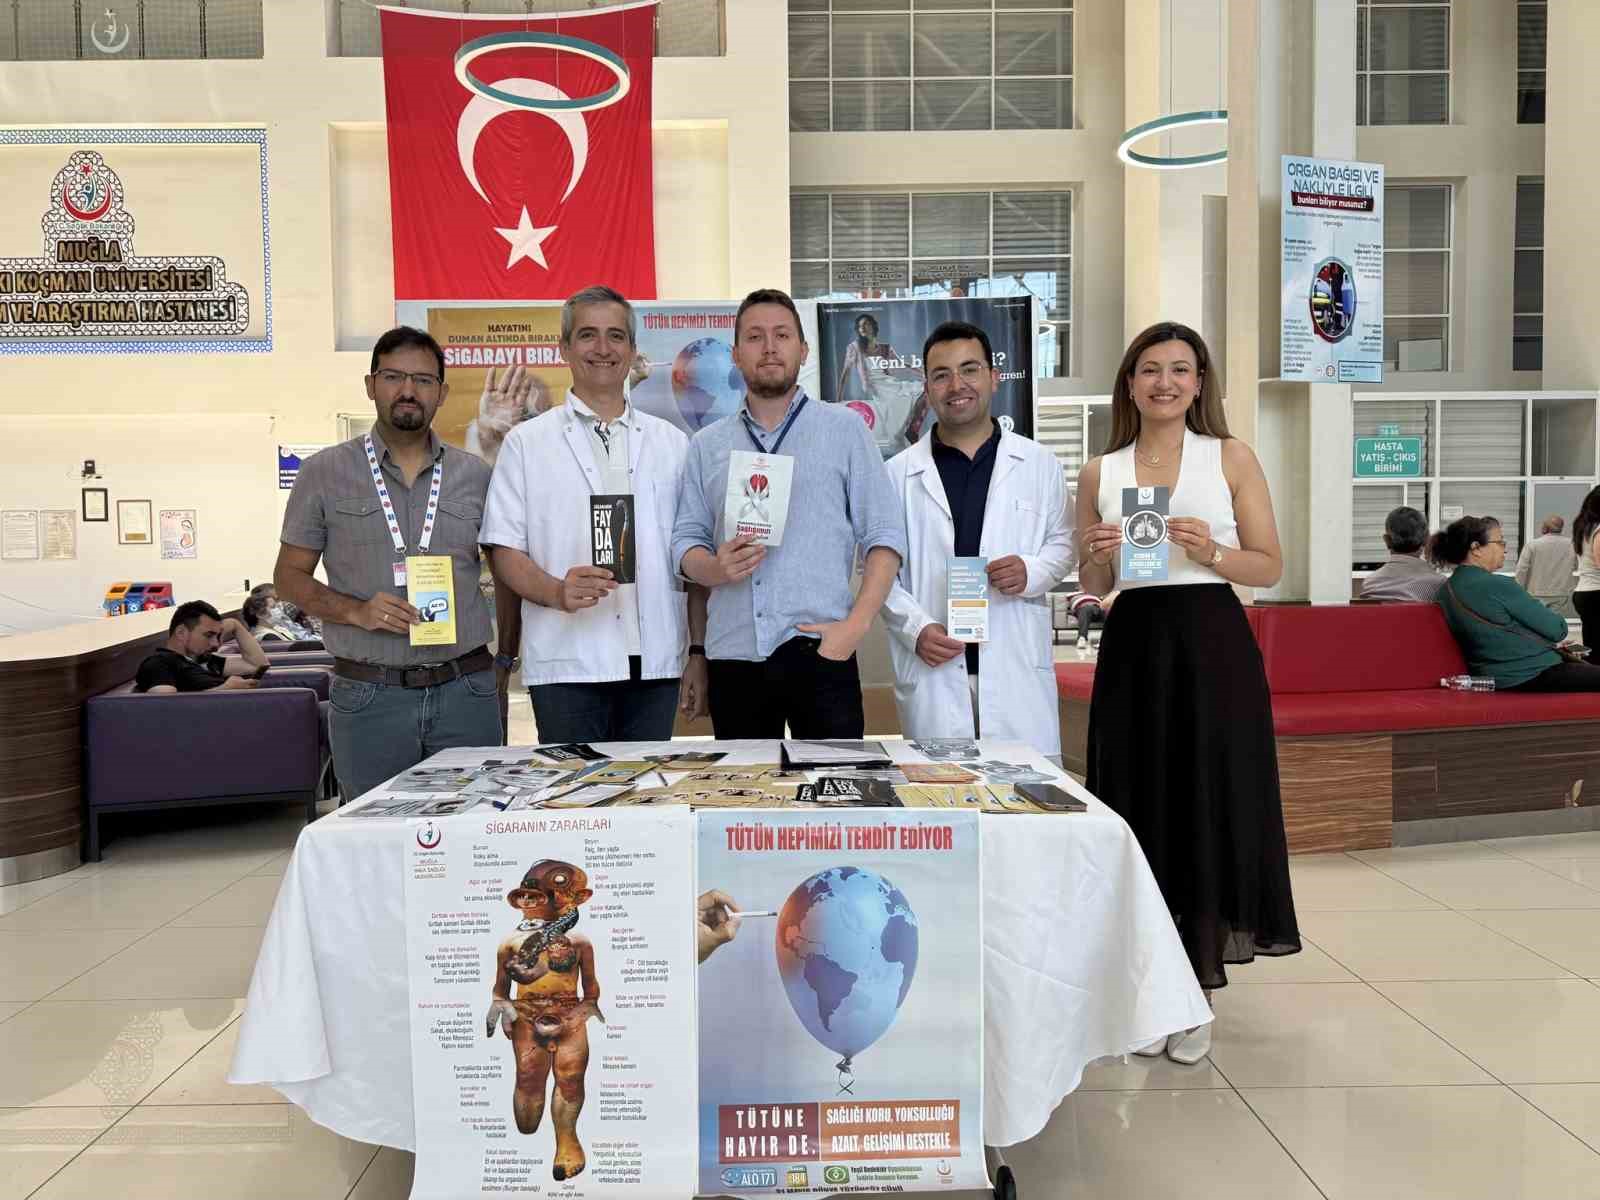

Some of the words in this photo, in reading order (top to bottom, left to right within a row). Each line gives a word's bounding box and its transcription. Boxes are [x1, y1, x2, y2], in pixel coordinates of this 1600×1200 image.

[1287, 162, 1327, 179] ORGAN
[1364, 170, 1379, 184] VE
[57, 237, 122, 262] MUĞLA
[15, 271, 92, 298] KOÇMAN
[94, 266, 213, 292] ÜNİVERSİTESİ
[10, 302, 33, 322] VE
[36, 301, 138, 327] ARAŞTIRMA
[140, 296, 235, 322] HASTANESİ
[526, 347, 562, 364] BIRA
[869, 354, 906, 369] Yeni
[1374, 442, 1403, 451] HASTA
[550, 818, 611, 832] ZARARLARI
[726, 822, 774, 851] TÜTÜN
[778, 822, 842, 850] HEPİMİZİ
[846, 822, 896, 850] TEHDİT
[901, 821, 953, 850] EDİYOR
[736, 1106, 804, 1128] TÜTÜNE
[826, 1106, 863, 1124] SAĞLIĞI
[895, 1104, 954, 1121] YOKSULLUĞU
[725, 1136, 778, 1157] HAYIR
[788, 1134, 816, 1155] DE.
[863, 1131, 904, 1154] GELİŞİMİ
[906, 1132, 951, 1150] DESTEKLE
[741, 1173, 759, 1185] ALO
[761, 1173, 775, 1185] 171
